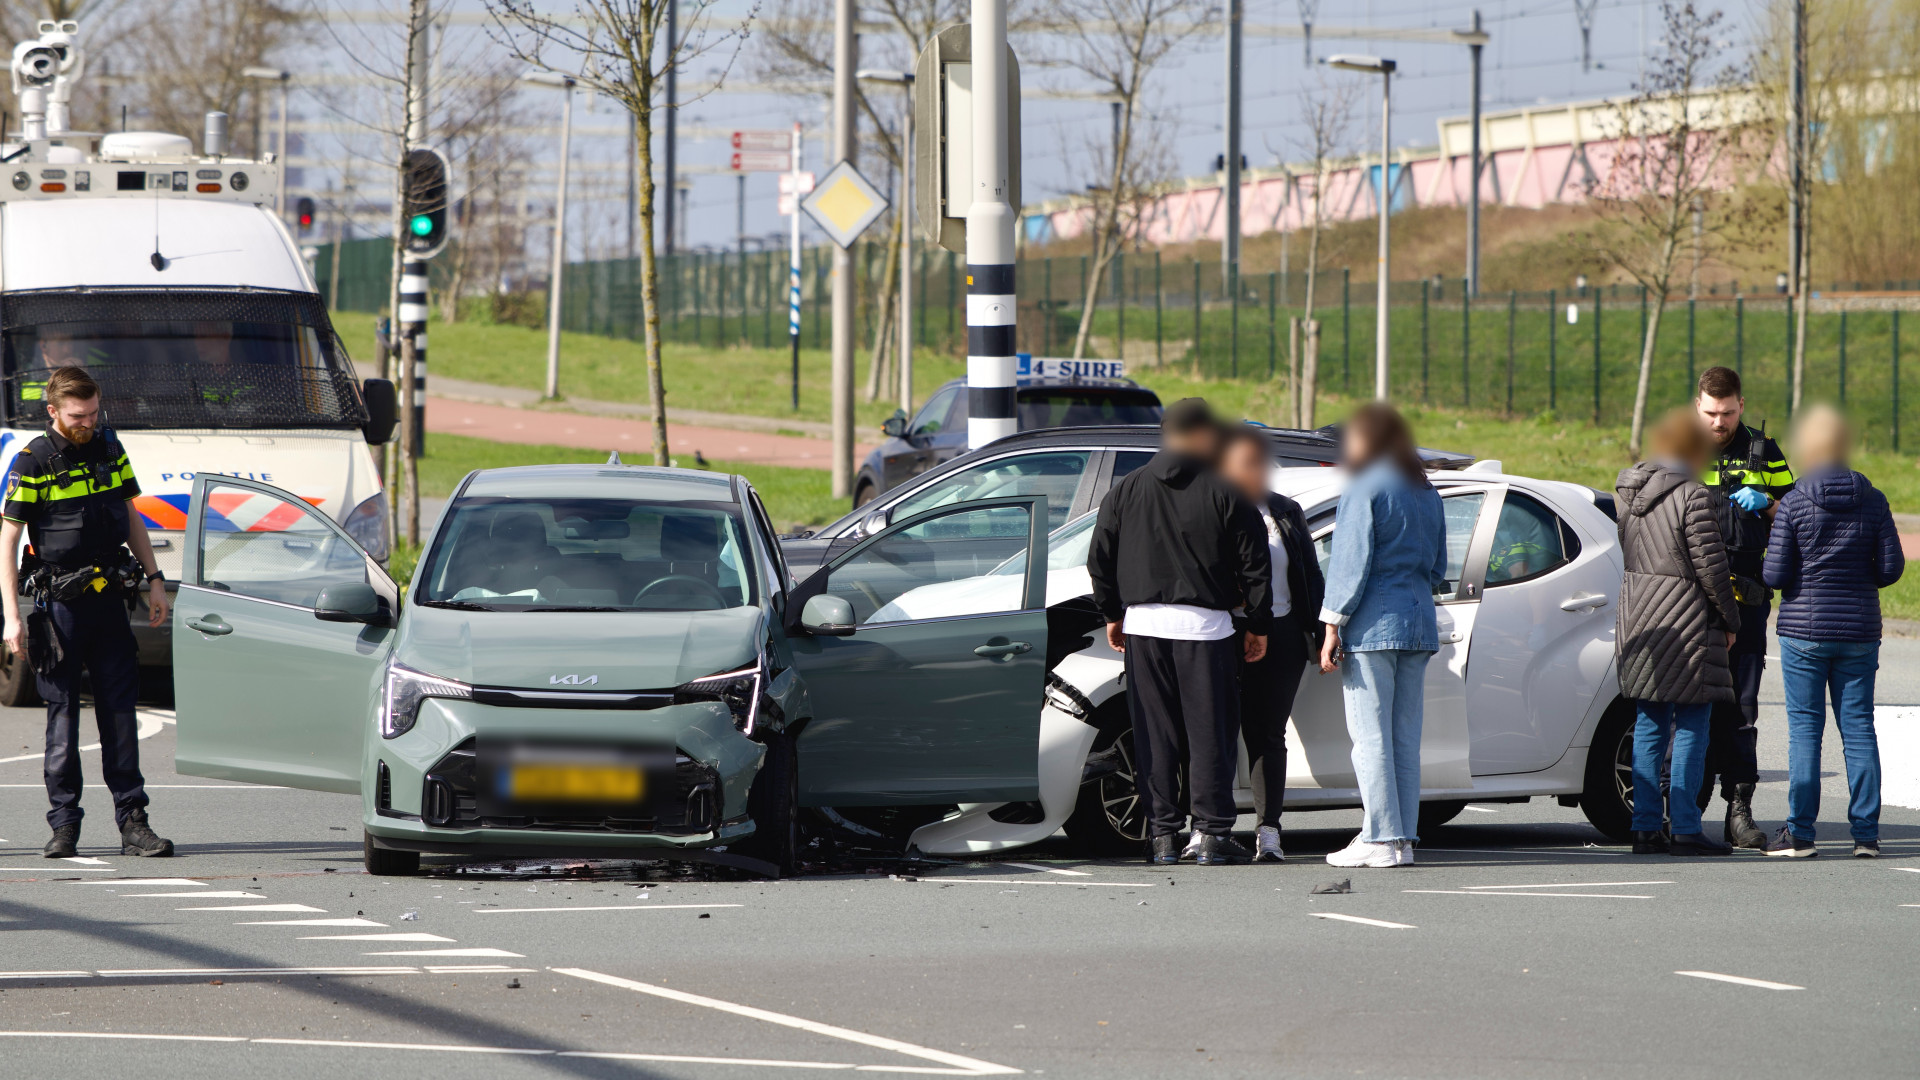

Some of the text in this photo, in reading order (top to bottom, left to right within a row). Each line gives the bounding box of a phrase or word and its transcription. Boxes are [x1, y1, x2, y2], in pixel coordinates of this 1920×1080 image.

[1033, 360, 1123, 379] 4-SURE
[161, 472, 274, 482] POTIE
[550, 674, 598, 686] KIA
